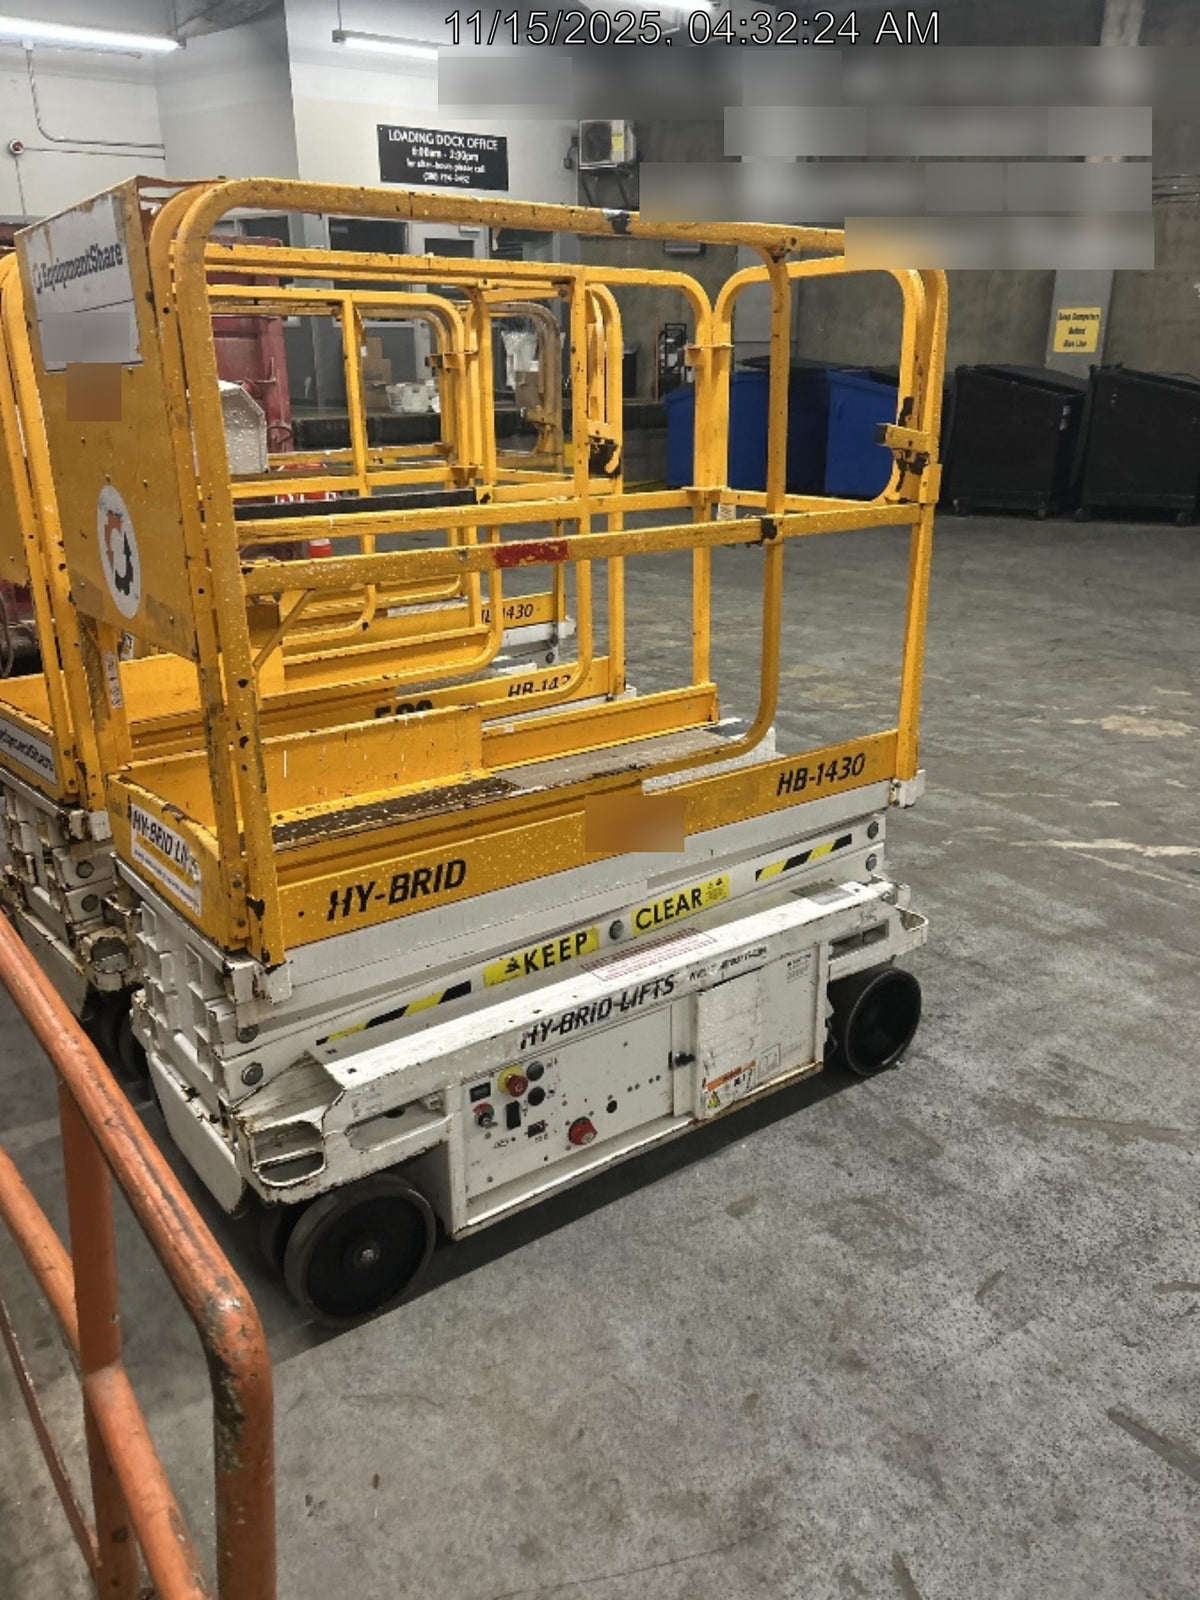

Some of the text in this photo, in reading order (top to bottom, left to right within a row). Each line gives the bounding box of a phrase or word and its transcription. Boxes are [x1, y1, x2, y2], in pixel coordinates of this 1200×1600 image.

[388, 129, 498, 151] LOADING DOCK OFFICE
[41, 243, 124, 291] EquipmentShare
[777, 752, 866, 797] HB-1430
[132, 810, 173, 856] HY-BRID
[327, 859, 467, 921] HY-BRID
[523, 932, 588, 975] KEEP
[635, 887, 703, 931] CLEAR
